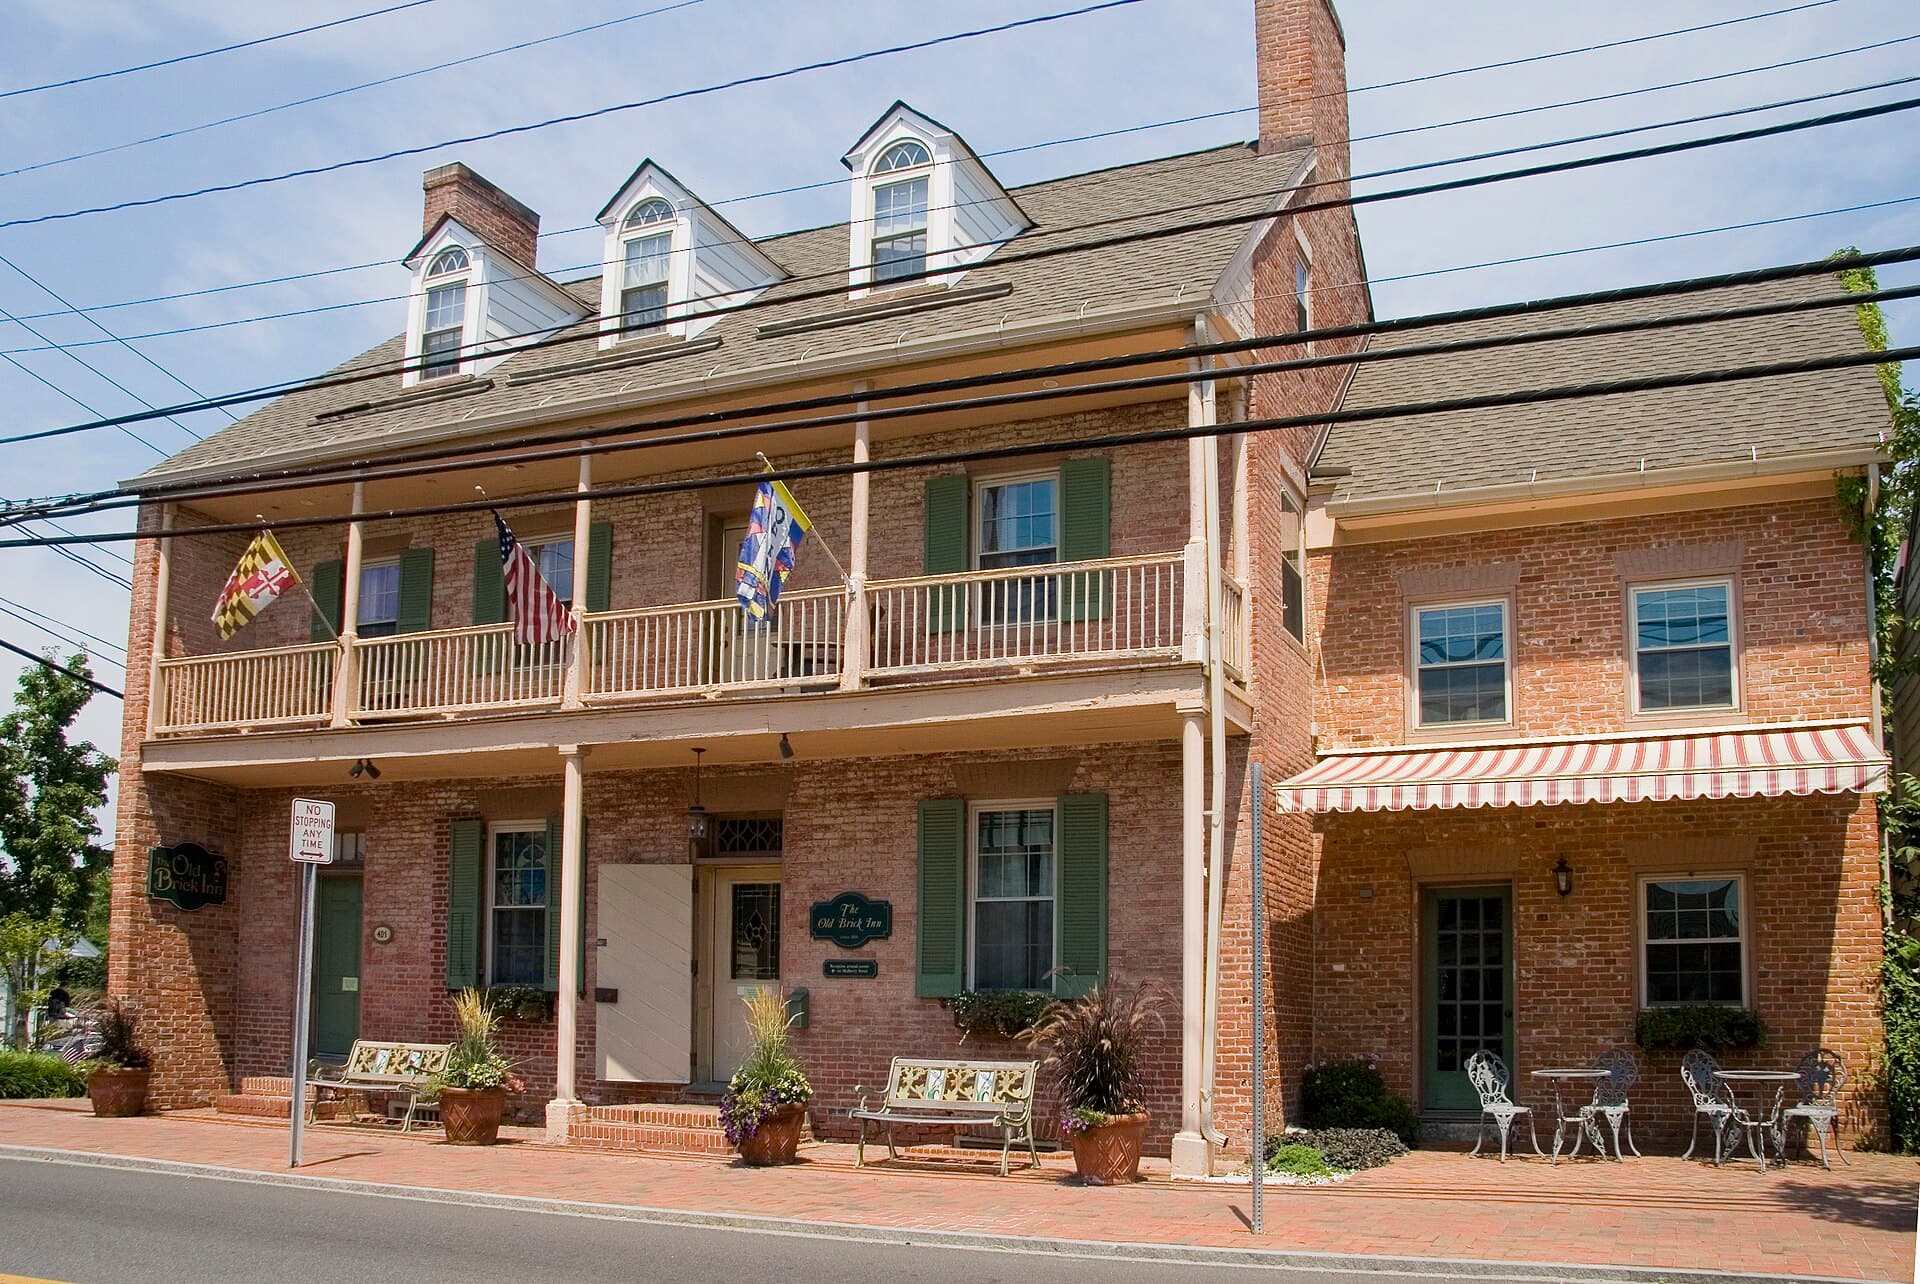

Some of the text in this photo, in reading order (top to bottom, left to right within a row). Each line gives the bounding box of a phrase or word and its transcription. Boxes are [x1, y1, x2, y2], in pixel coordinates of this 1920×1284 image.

[306, 804, 321, 816] NO
[295, 815, 331, 829] STOPPING
[302, 829, 322, 838] ANY
[302, 839, 323, 849] TIME
[172, 854, 201, 877] Old
[154, 867, 224, 895] Brick Inn
[840, 903, 859, 917] The
[817, 917, 882, 932] Old Brick Inn
